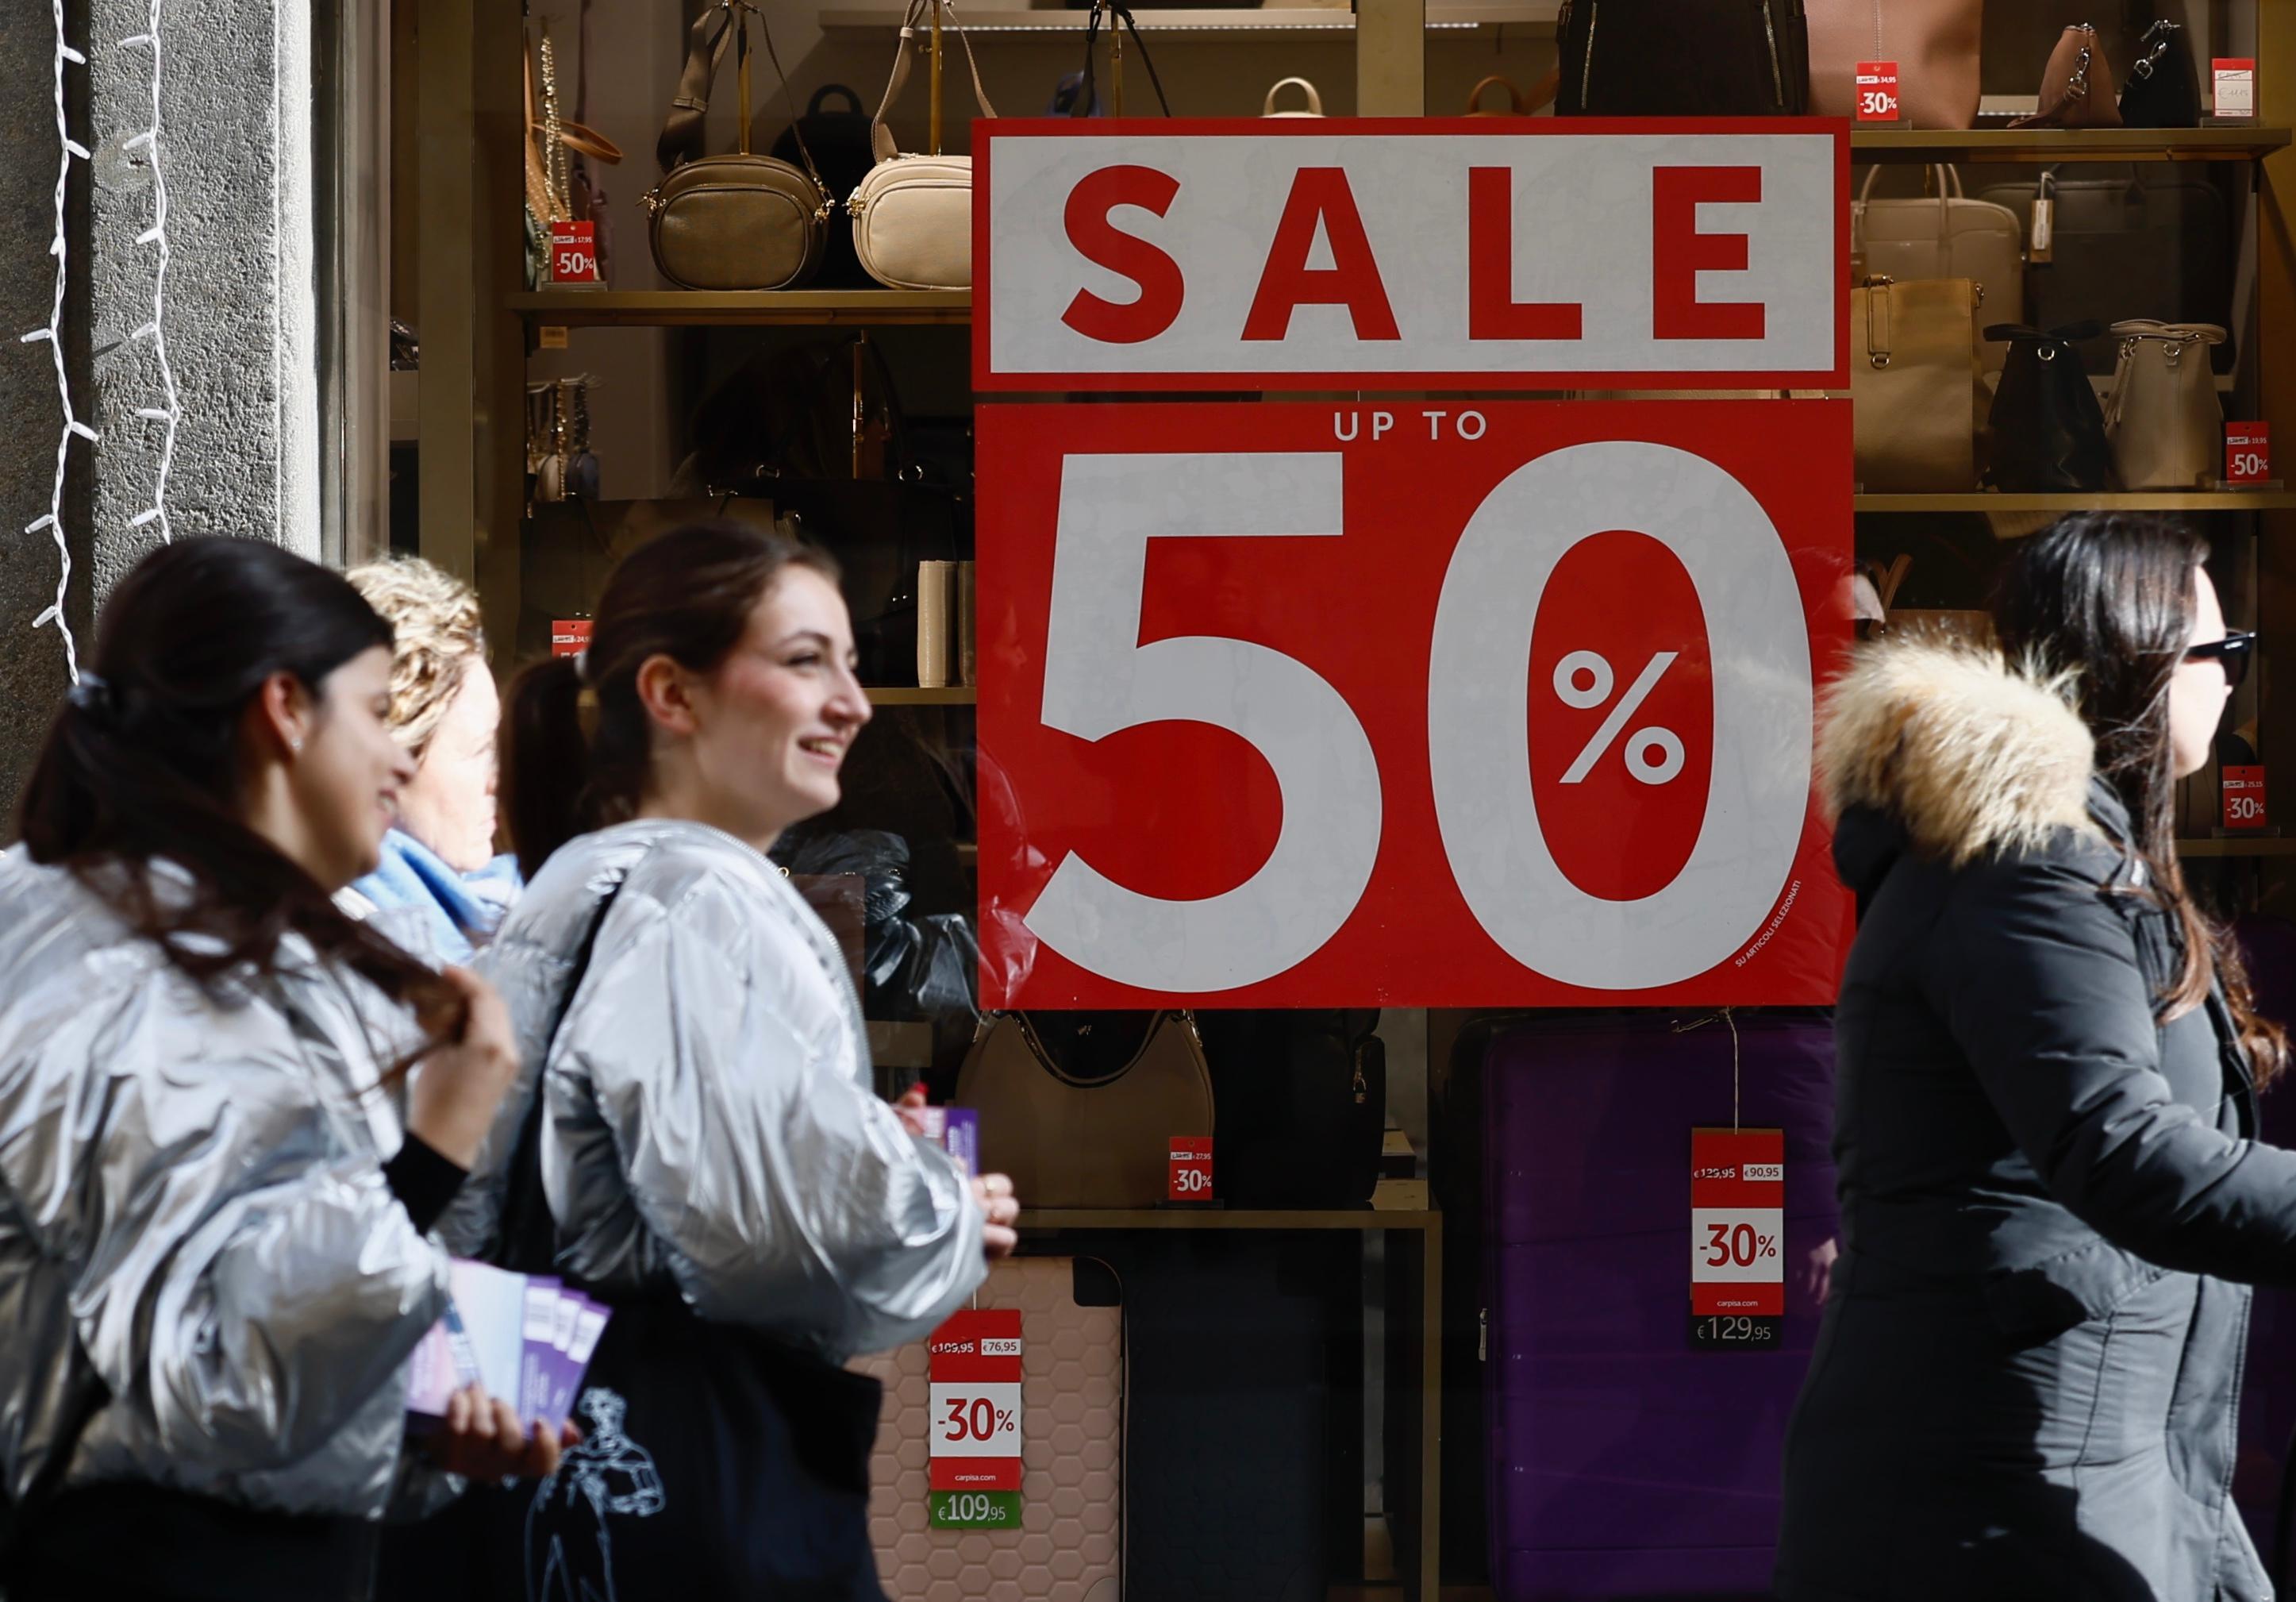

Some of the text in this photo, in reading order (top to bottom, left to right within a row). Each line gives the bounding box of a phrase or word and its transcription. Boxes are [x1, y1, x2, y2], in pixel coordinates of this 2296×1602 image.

[1859, 92, 1897, 114] -30%
[556, 252, 594, 274] -50%
[1061, 165, 1765, 344] SALE
[1335, 411, 1486, 441] UP TO
[2230, 453, 2268, 476] -50%
[2227, 797, 2264, 819] -30%
[1735, 880, 1802, 967] SU ARTICOLI SELEZIONATI
[1174, 1169, 1212, 1191] -30%
[1699, 1223, 1776, 1267] -30%
[1717, 1300, 1758, 1309] carpisa.com
[937, 1397, 1014, 1442] -30%
[955, 1473, 996, 1483] carpisa.com
